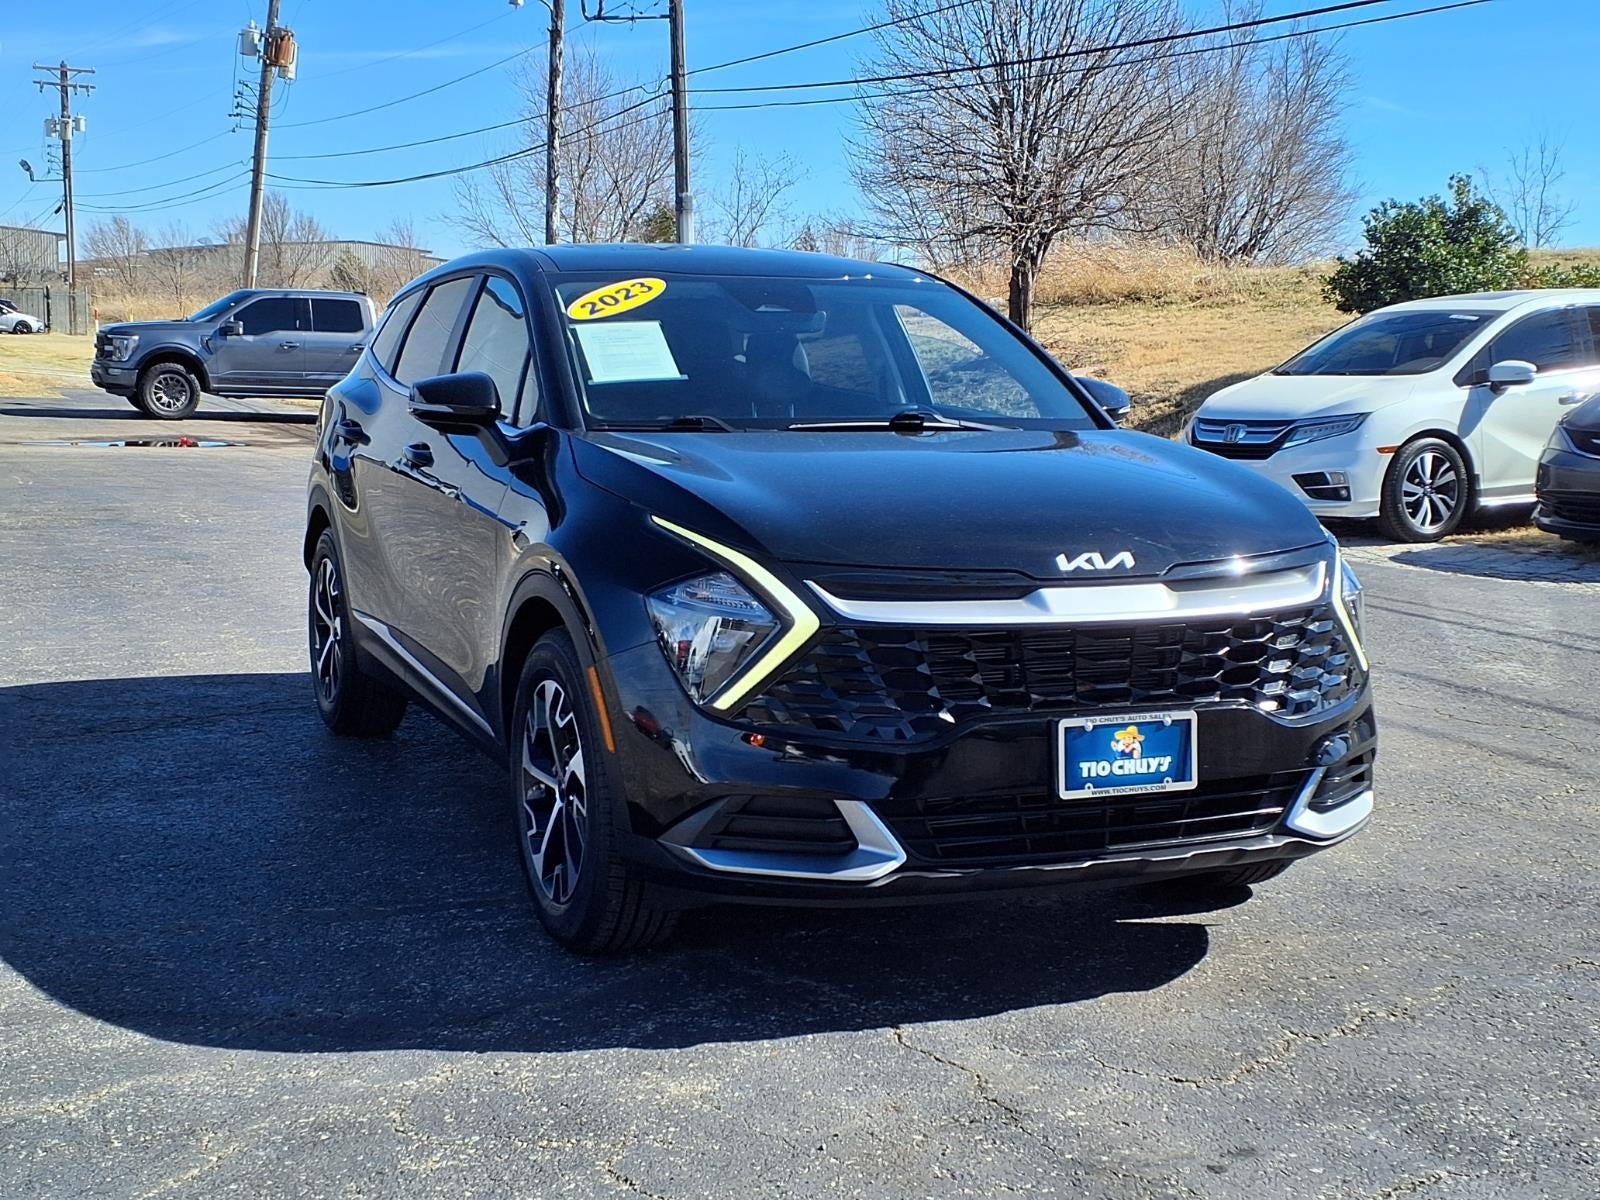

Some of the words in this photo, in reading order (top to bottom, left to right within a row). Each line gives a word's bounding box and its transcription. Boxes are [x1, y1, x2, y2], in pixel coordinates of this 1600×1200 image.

[580, 282, 653, 315] 2023
[1055, 551, 1136, 571] KIA
[1127, 714, 1147, 722] AUTO
[1079, 760, 1111, 778] TIO
[1111, 755, 1172, 776] CHUY'S
[1091, 784, 1167, 796] WWW.TIOCHUYS.COM
